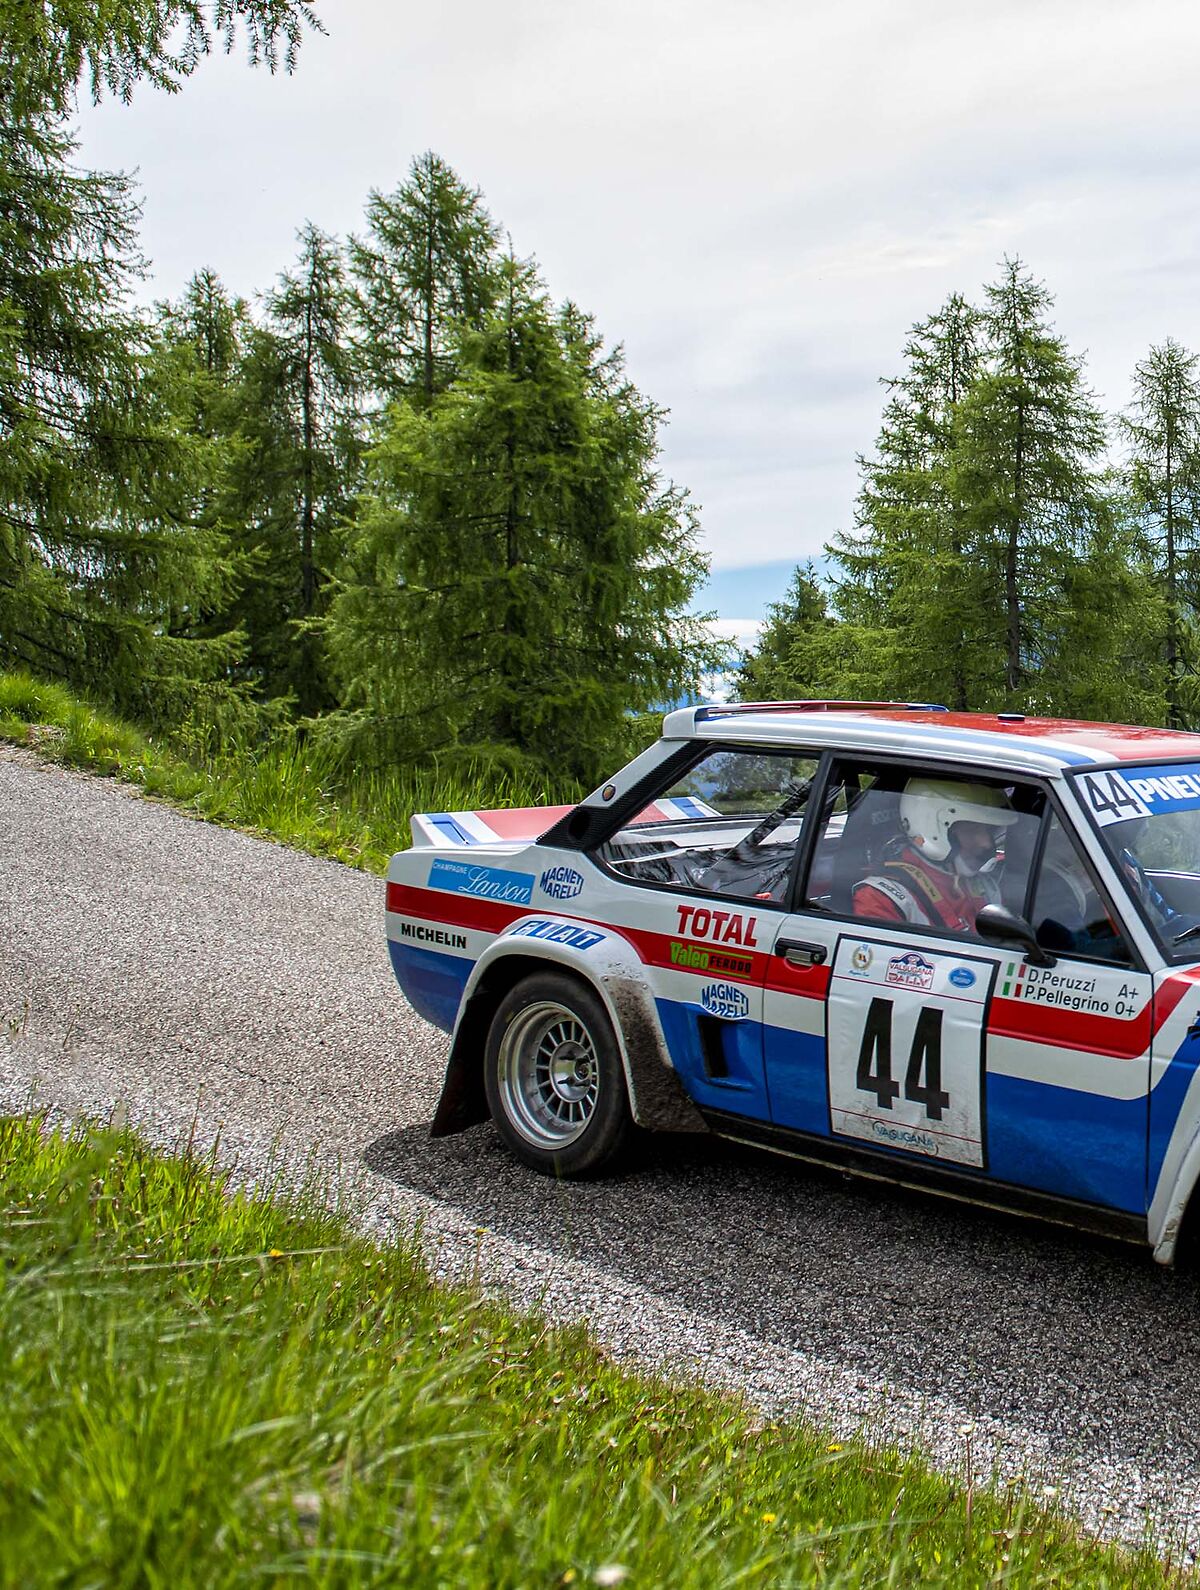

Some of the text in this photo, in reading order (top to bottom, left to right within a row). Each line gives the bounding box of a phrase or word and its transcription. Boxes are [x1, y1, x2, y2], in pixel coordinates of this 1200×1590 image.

[1084, 771, 1142, 817] 44
[433, 861, 530, 902] CHAMPAGNE Lanson
[401, 923, 467, 949] MICHELIN
[513, 921, 603, 948] FIAT
[677, 905, 757, 947] TOTAL
[671, 942, 752, 974] Valeo FERODO
[1025, 985, 1109, 1013] P.Pellegrino
[1028, 968, 1139, 999] D.Peruzzi A+
[856, 997, 950, 1121] 44
